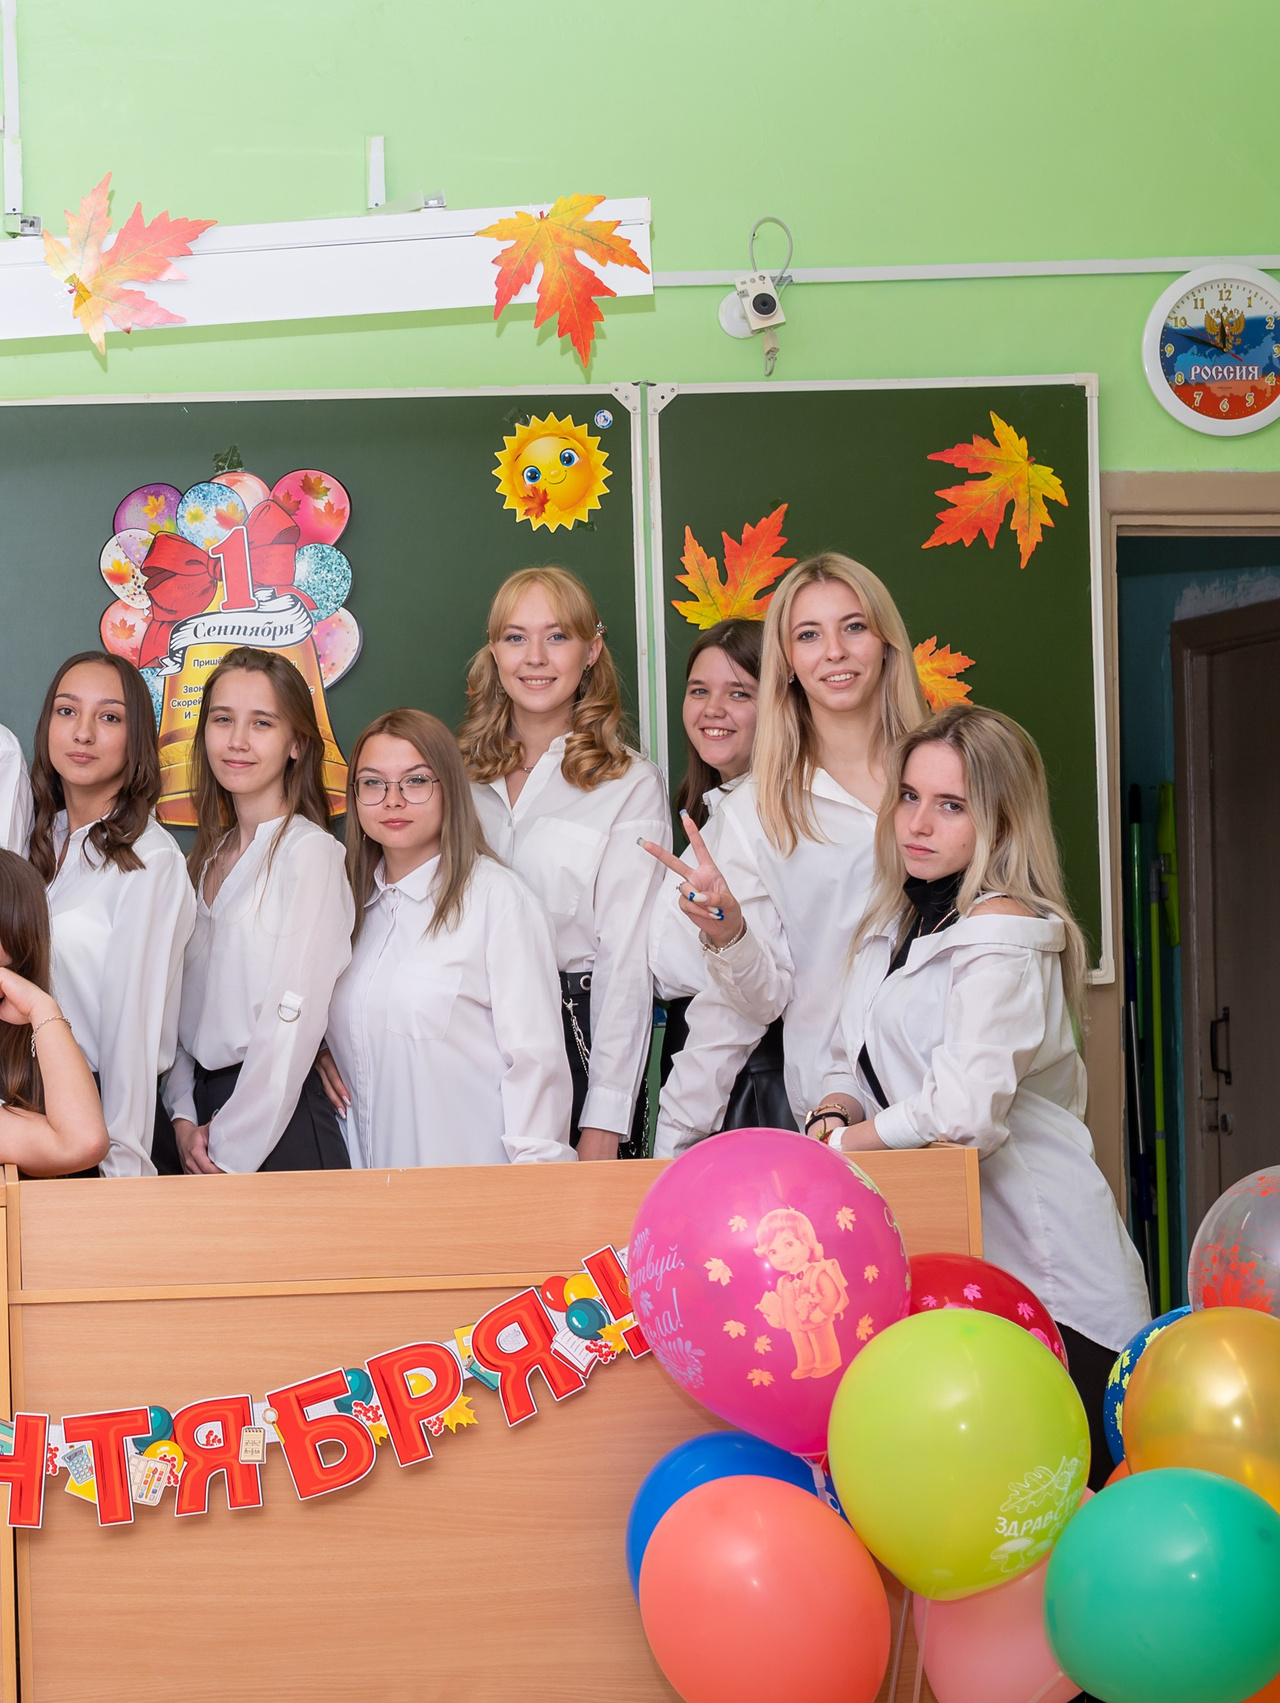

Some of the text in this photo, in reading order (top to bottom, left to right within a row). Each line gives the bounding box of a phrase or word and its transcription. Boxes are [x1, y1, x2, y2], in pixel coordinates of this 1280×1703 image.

[1219, 289, 1232, 301] 12
[1193, 298, 1205, 309] 11
[1247, 296, 1253, 308] 1
[1173, 316, 1187, 328] 10
[1266, 316, 1275, 329] 2
[1165, 343, 1174, 357] 9
[1175, 372, 1184, 385] 8
[1190, 365, 1260, 380] РОССИЯ
[1265, 372, 1276, 386] 4
[1194, 392, 1203, 406] 7
[1219, 398, 1229, 412] 6
[1245, 393, 1254, 406] 5
[208, 525, 260, 613] 1
[193, 620, 295, 641] Сентября
